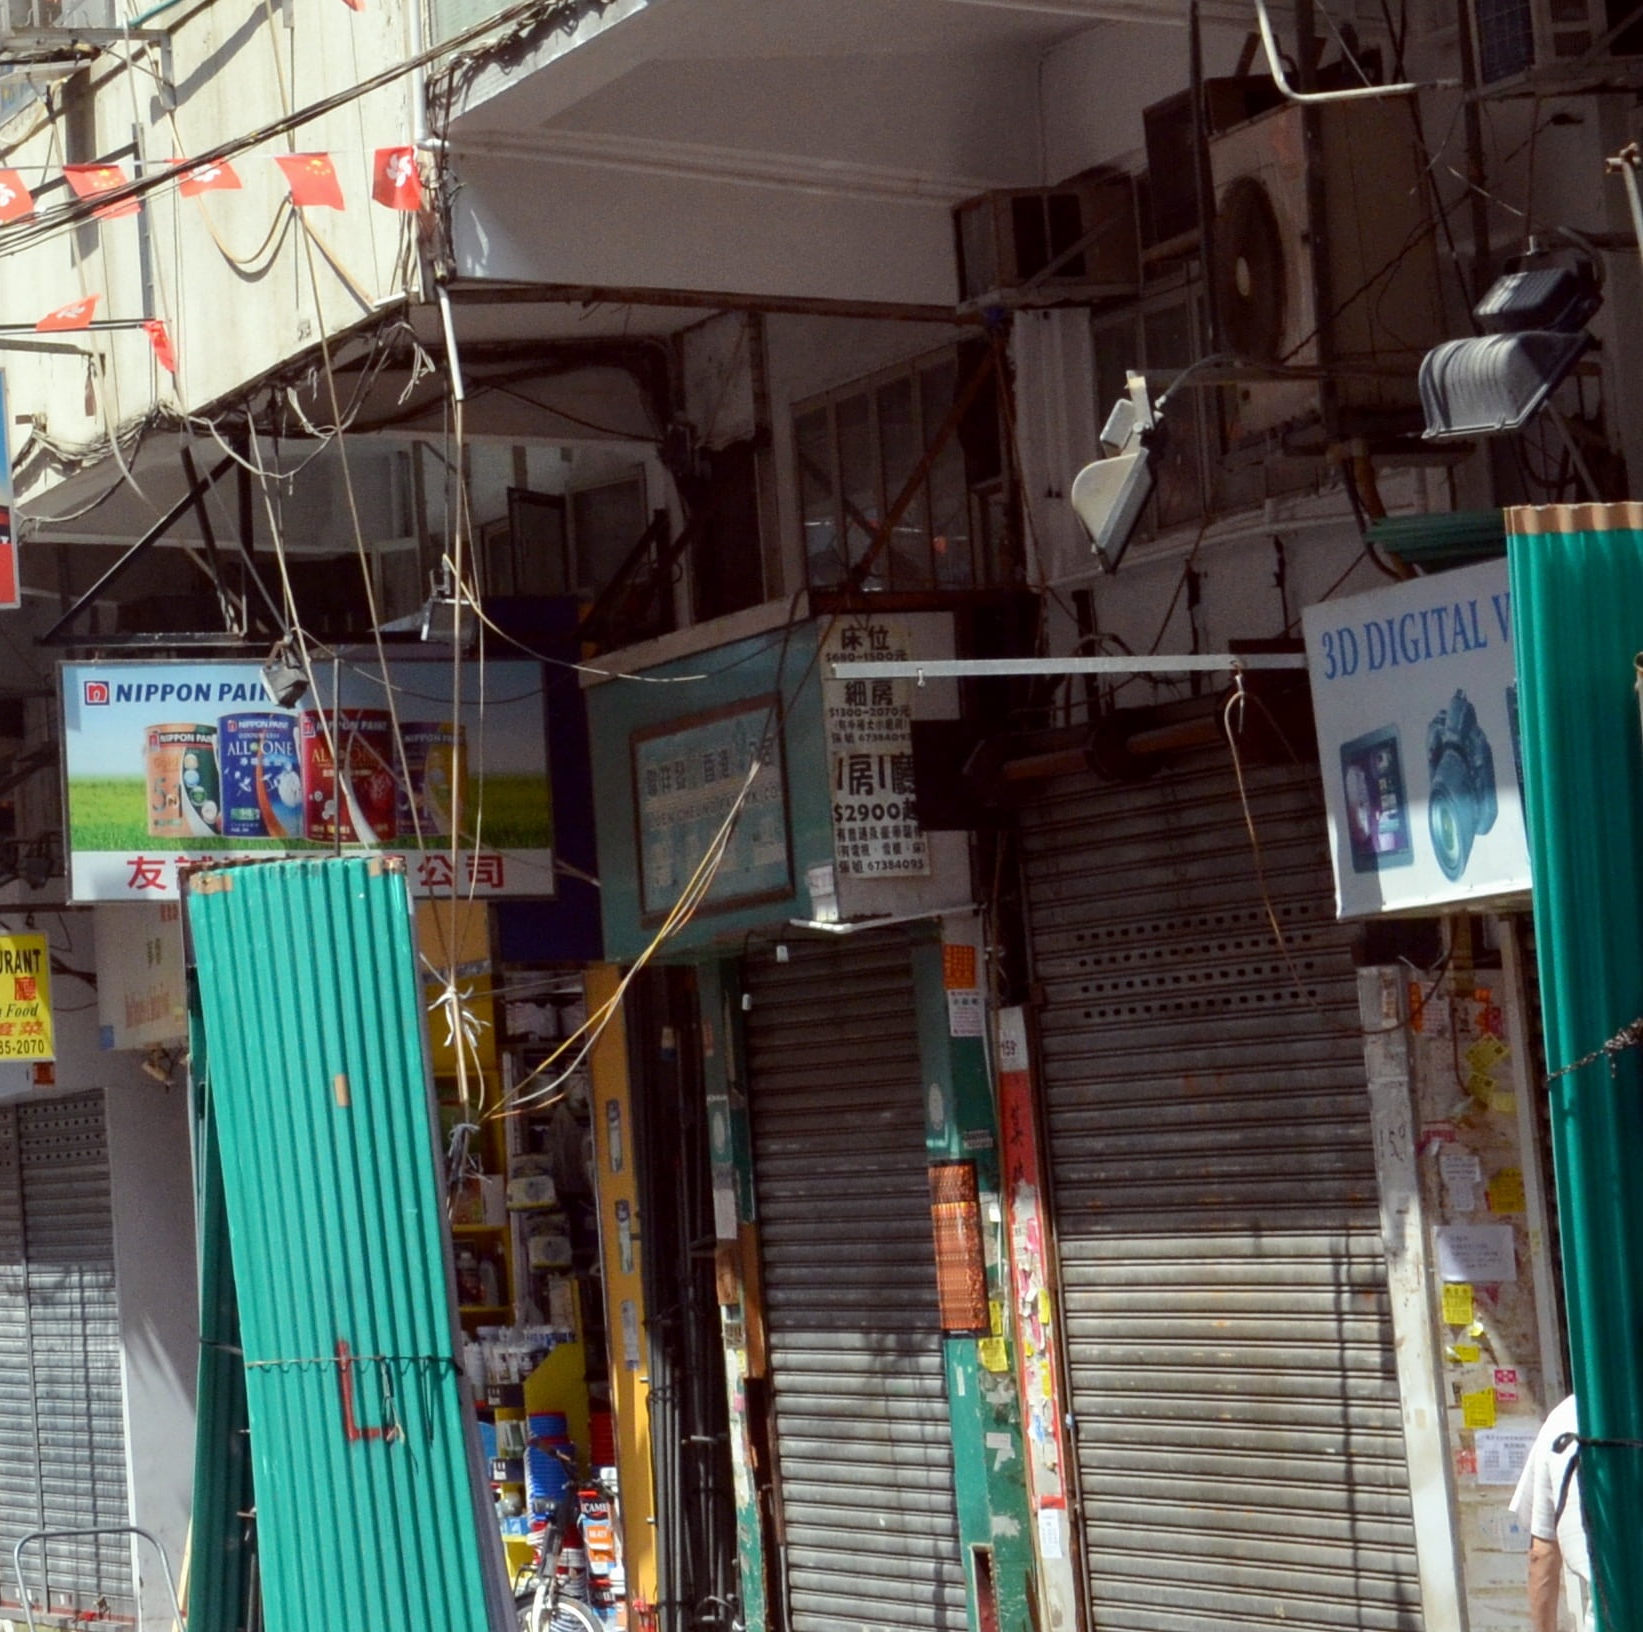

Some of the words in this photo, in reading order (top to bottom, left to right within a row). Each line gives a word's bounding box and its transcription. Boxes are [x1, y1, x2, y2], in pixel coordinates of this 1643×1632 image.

[1322, 627, 1359, 680] 3D
[1363, 599, 1488, 672] DIGITAL
[116, 683, 212, 702] NIPPON
[218, 682, 271, 702] PAI
[5, 1003, 39, 1018] Food
